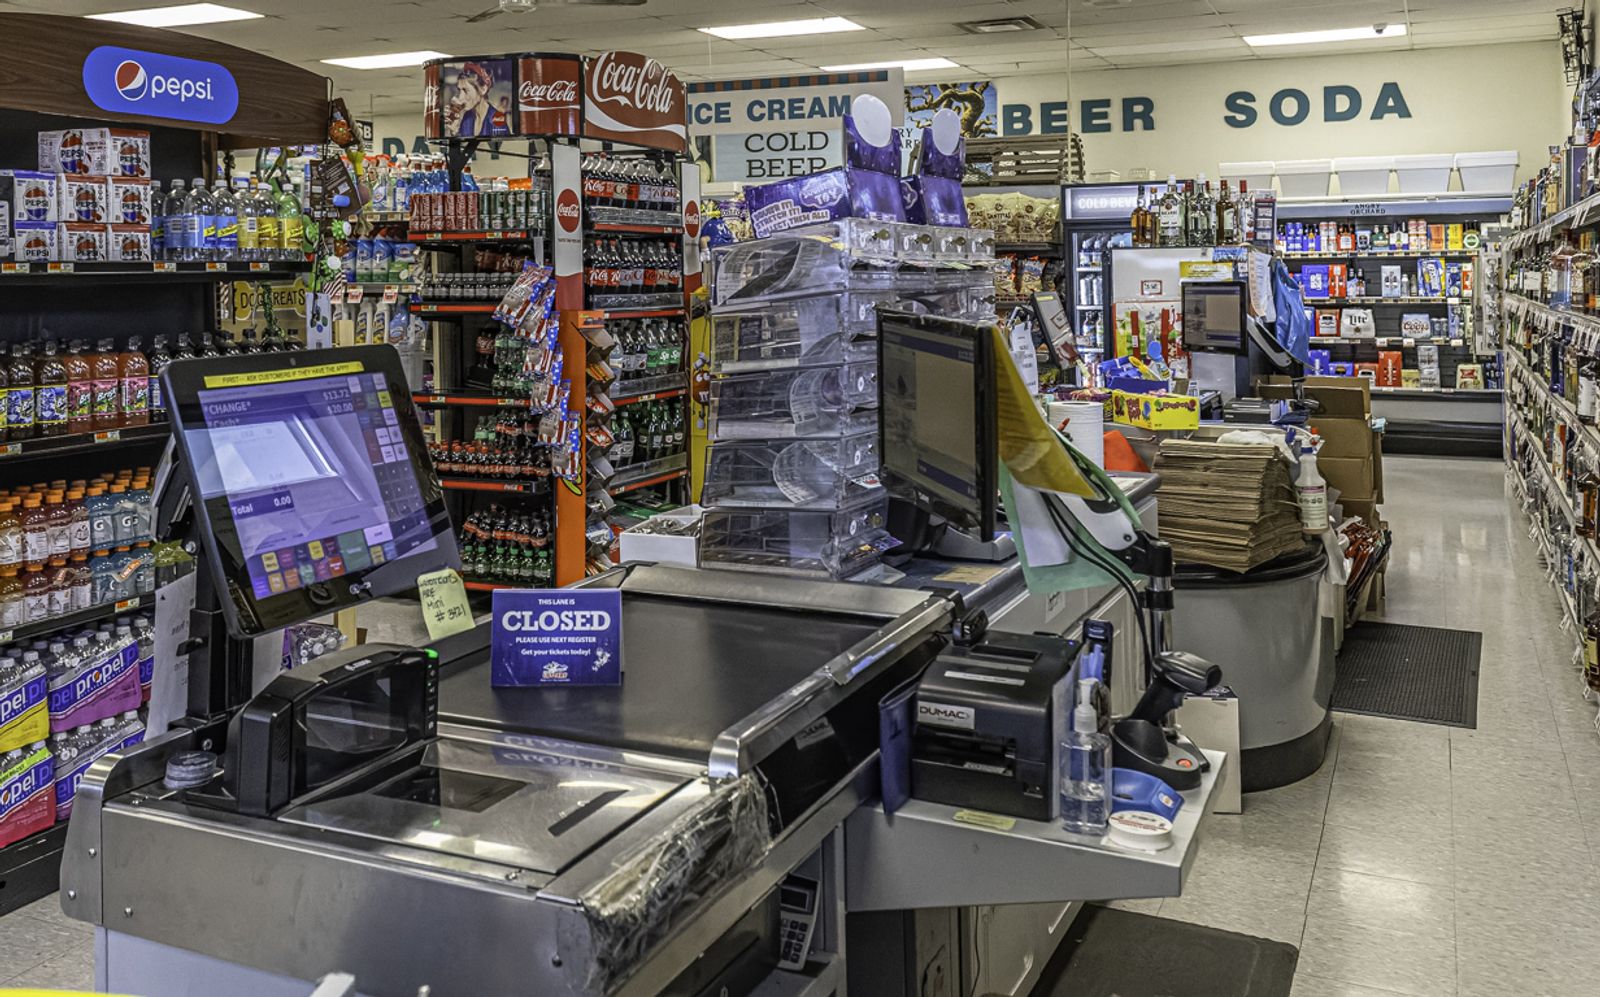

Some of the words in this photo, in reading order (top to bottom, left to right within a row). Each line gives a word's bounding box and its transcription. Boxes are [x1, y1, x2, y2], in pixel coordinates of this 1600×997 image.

[152, 75, 211, 102] pepsi
[519, 80, 577, 102] Coca-Cola
[592, 51, 673, 114] Coca-Cola
[688, 101, 732, 125] ICE
[746, 94, 851, 123] CREAM
[1002, 96, 1155, 136] BEER
[1224, 82, 1412, 128] SODA
[744, 131, 829, 153] COLD
[1079, 196, 1107, 209] COLD
[268, 288, 306, 307] REATS
[231, 504, 253, 516] Total
[273, 496, 292, 507] 0.00
[502, 611, 611, 631] CLOSED
[570, 649, 591, 657] today!
[76, 652, 124, 699] propel
[919, 706, 966, 720] DUMAC
